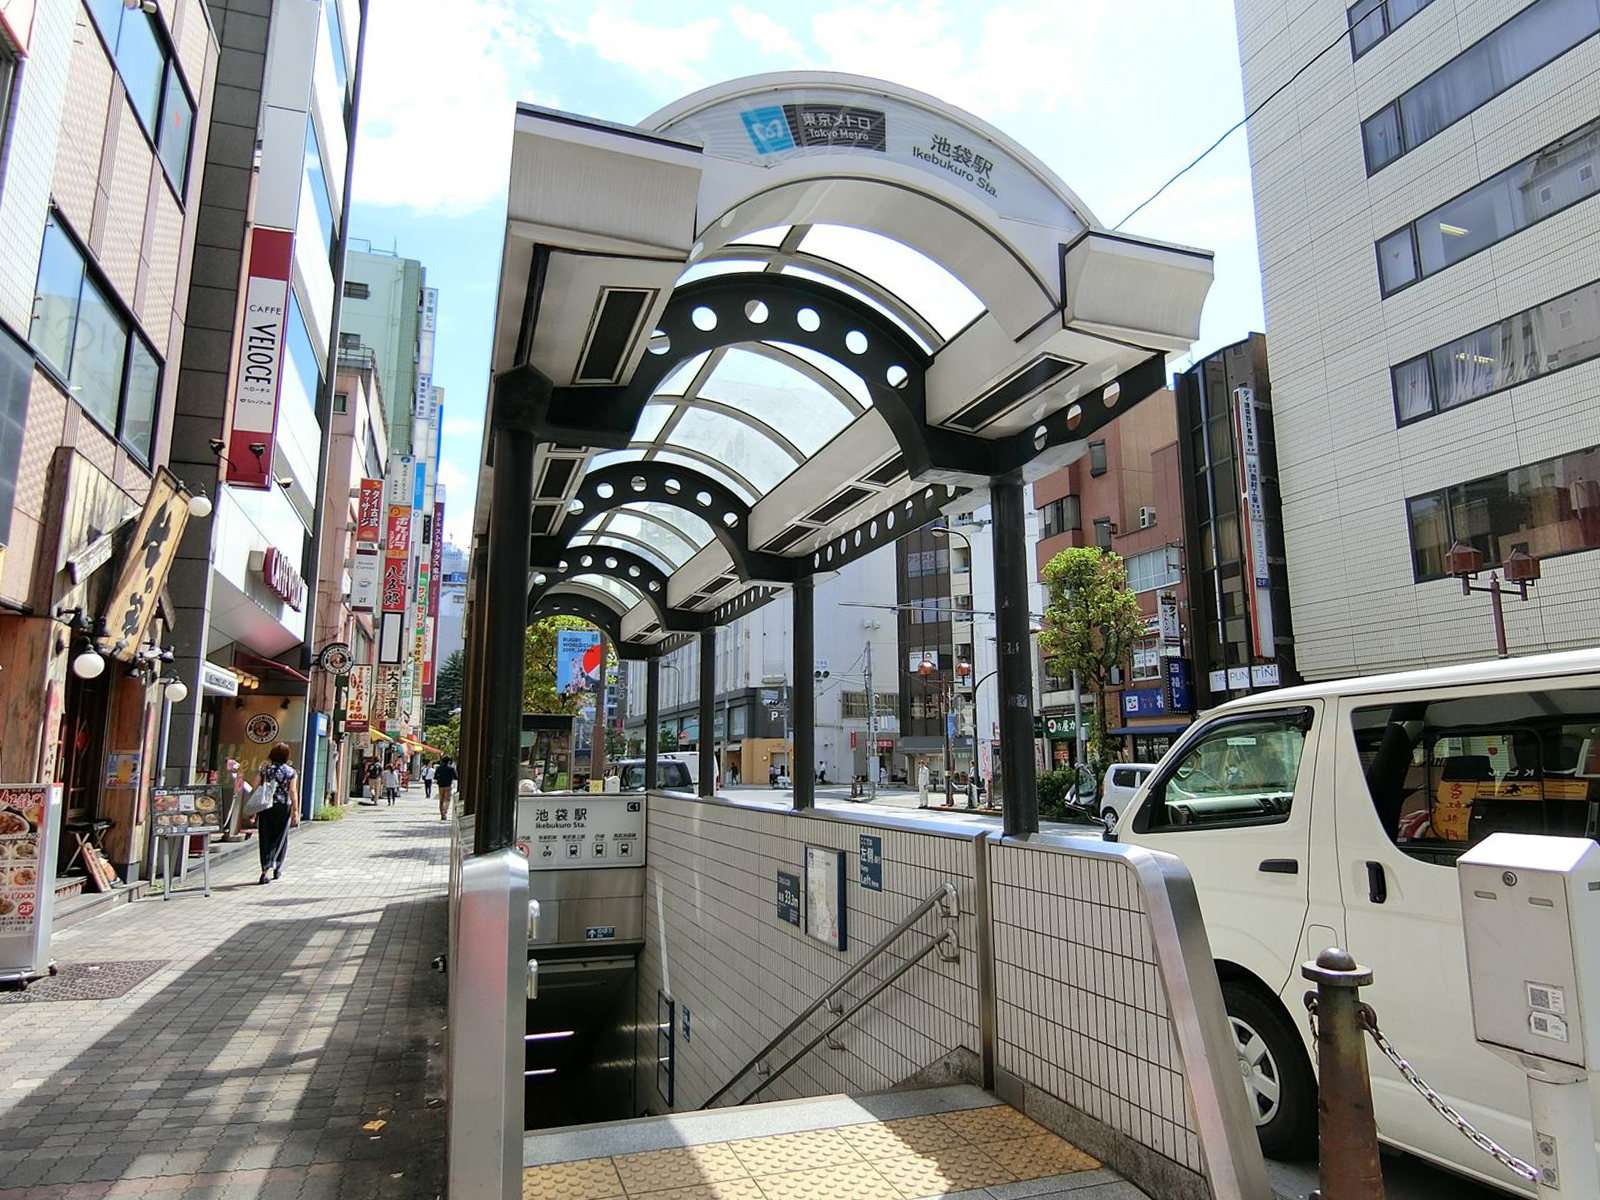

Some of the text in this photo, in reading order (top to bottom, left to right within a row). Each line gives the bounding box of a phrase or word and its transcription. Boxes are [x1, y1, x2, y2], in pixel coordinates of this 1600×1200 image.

[801, 113, 870, 130] 東京メトロ
[809, 129, 869, 140] Tokyo Metro
[931, 134, 993, 179] 池袋駅
[913, 146, 997, 198] Ikebukuro Sta.
[249, 304, 282, 315] CAFFE
[245, 324, 277, 384] VELOCE
[361, 489, 371, 527] マッサージ
[385, 566, 400, 605] 八五郎
[535, 808, 587, 821] 池袋駅
[628, 803, 639, 811] C1
